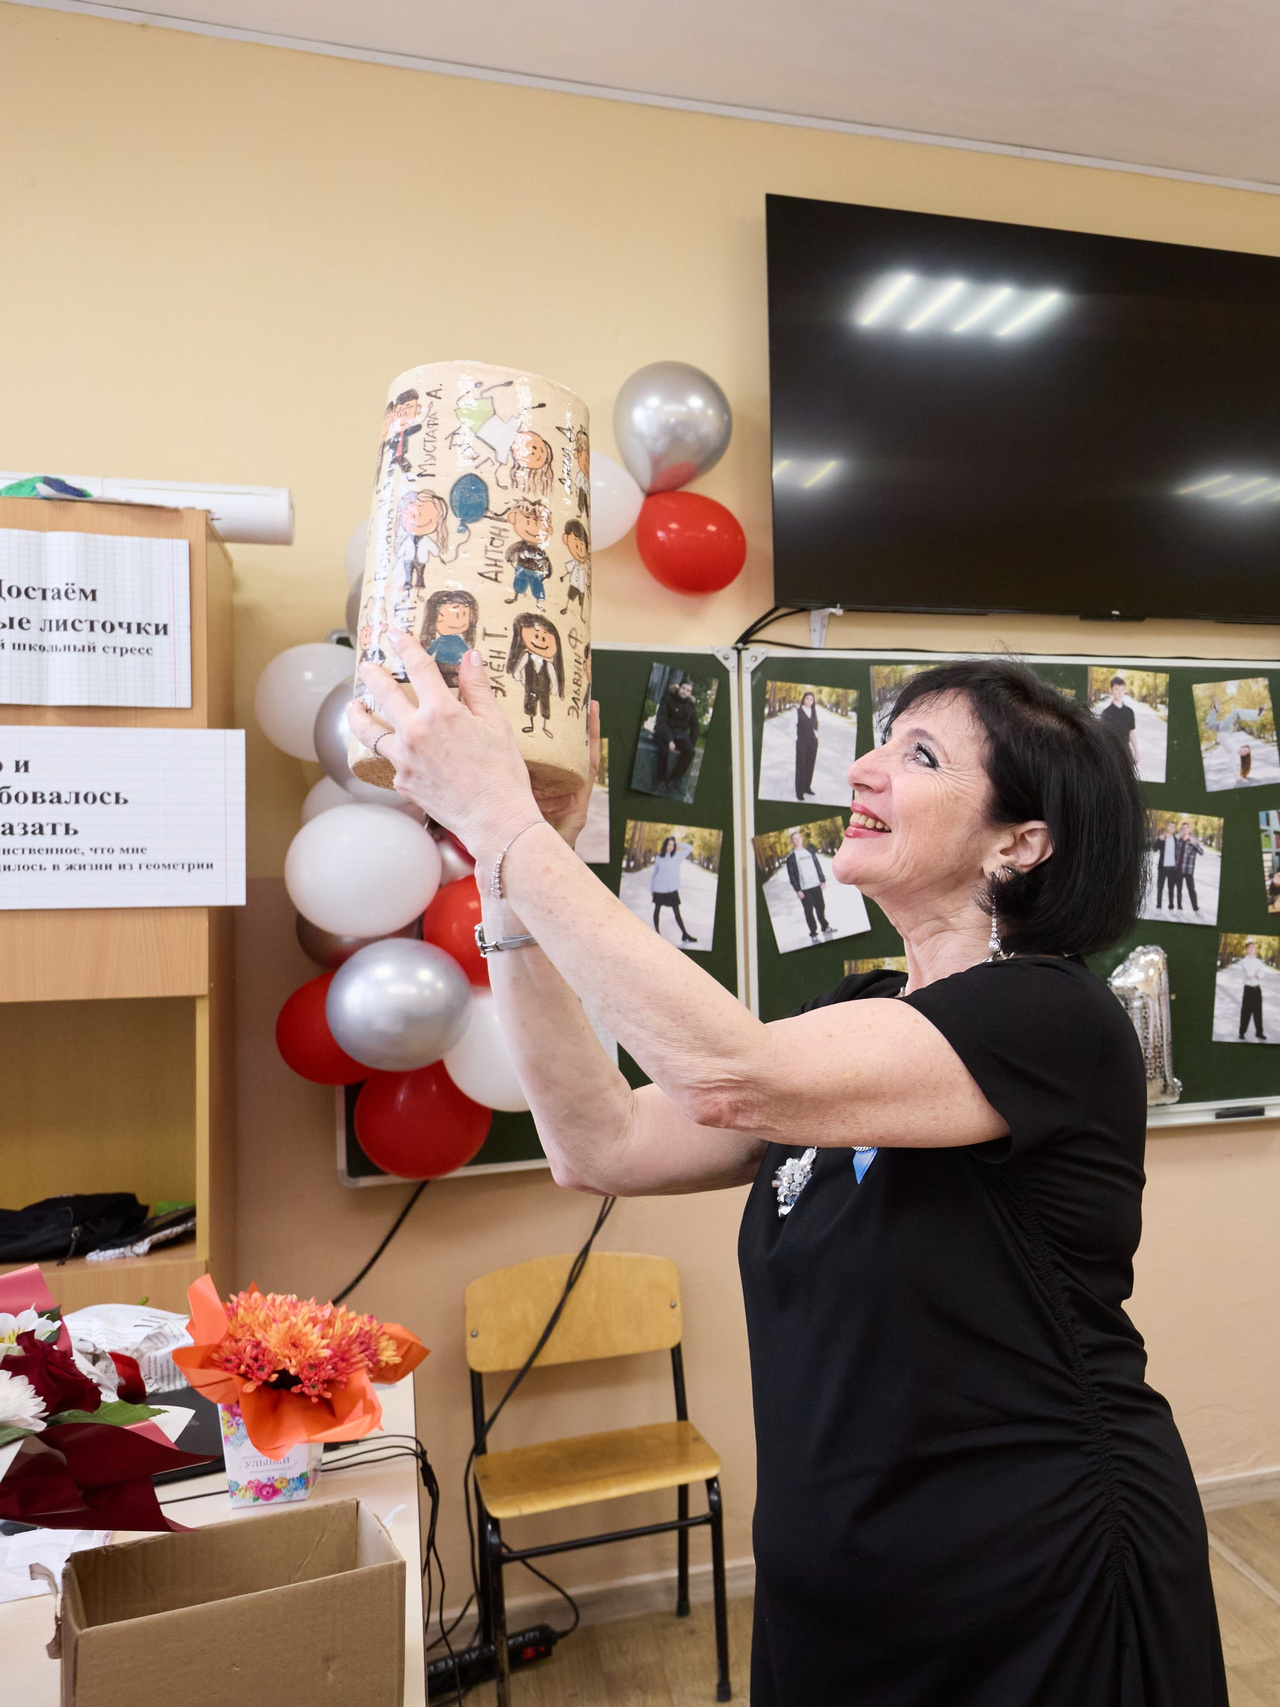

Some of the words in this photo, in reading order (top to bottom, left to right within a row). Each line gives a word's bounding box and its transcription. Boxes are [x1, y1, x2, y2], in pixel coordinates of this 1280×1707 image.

[477, 525, 510, 584] АНТОН
[0, 616, 31, 631] ые
[40, 616, 170, 636] листочки
[12, 641, 97, 654] школьный
[102, 645, 154, 658] стресс
[14, 759, 31, 774] и
[0, 785, 129, 806] бовалось
[0, 821, 79, 837] азать
[0, 846, 85, 858] нственное,
[89, 847, 115, 856] что
[119, 846, 148, 856] мне
[0, 862, 47, 873] илось
[52, 862, 61, 872] в
[65, 862, 113, 872] жизни
[118, 862, 134, 872] из
[138, 861, 215, 874] геометрии
